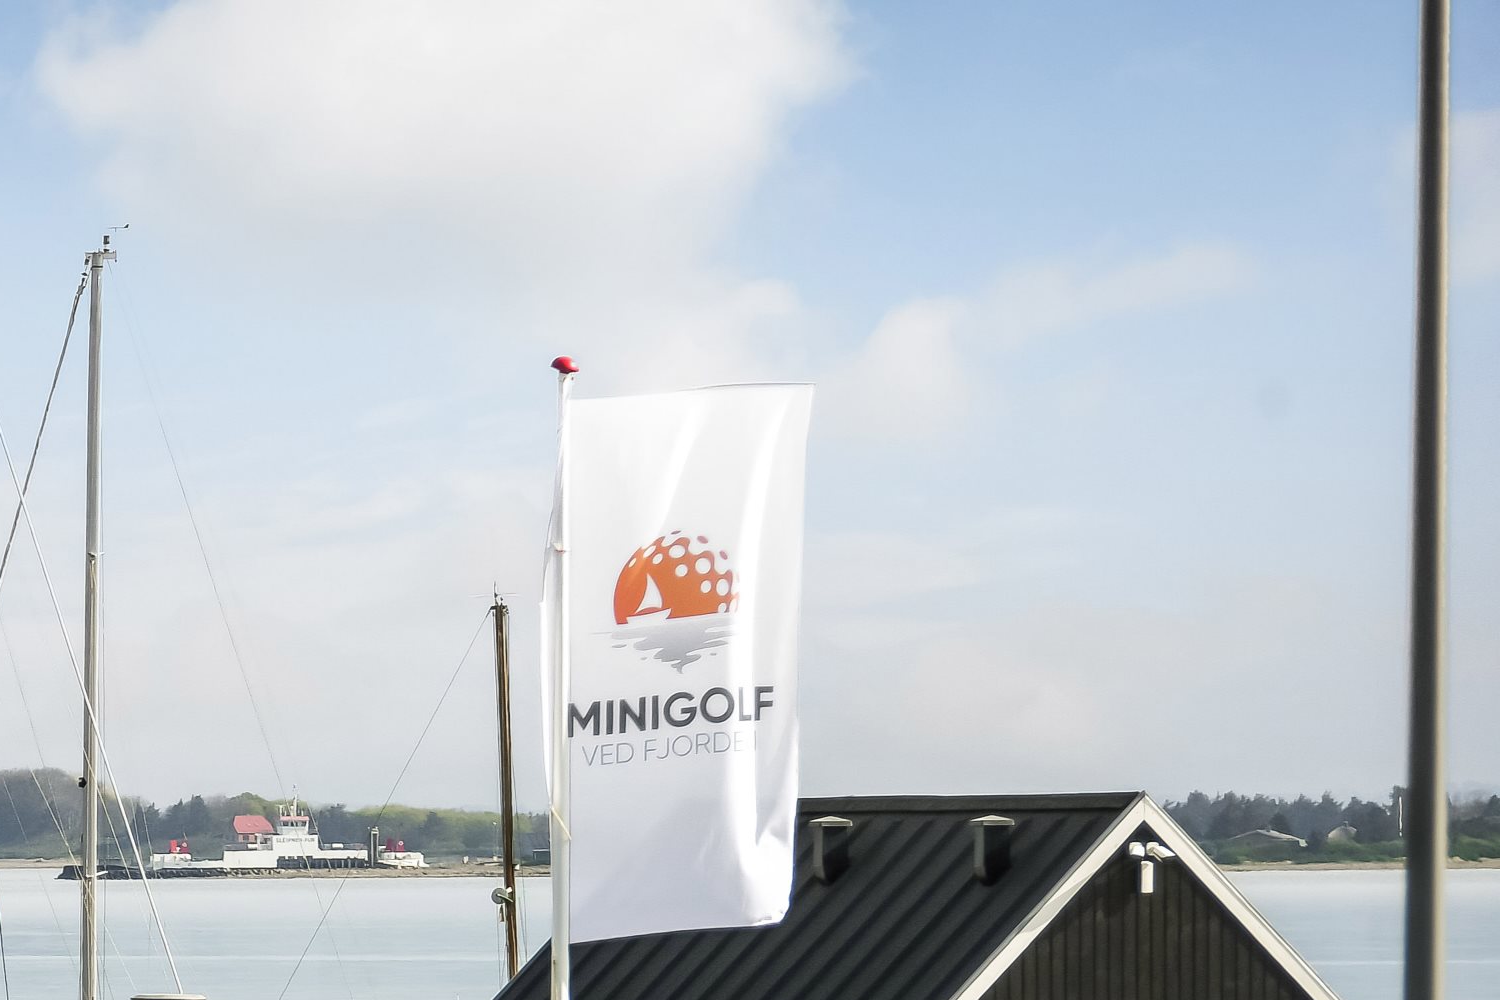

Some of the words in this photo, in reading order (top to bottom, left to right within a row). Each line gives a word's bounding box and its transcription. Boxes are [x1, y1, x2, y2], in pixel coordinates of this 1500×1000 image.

[567, 685, 774, 738] MINIGOLF
[581, 742, 635, 767] VED
[643, 730, 757, 763] FJORDE
